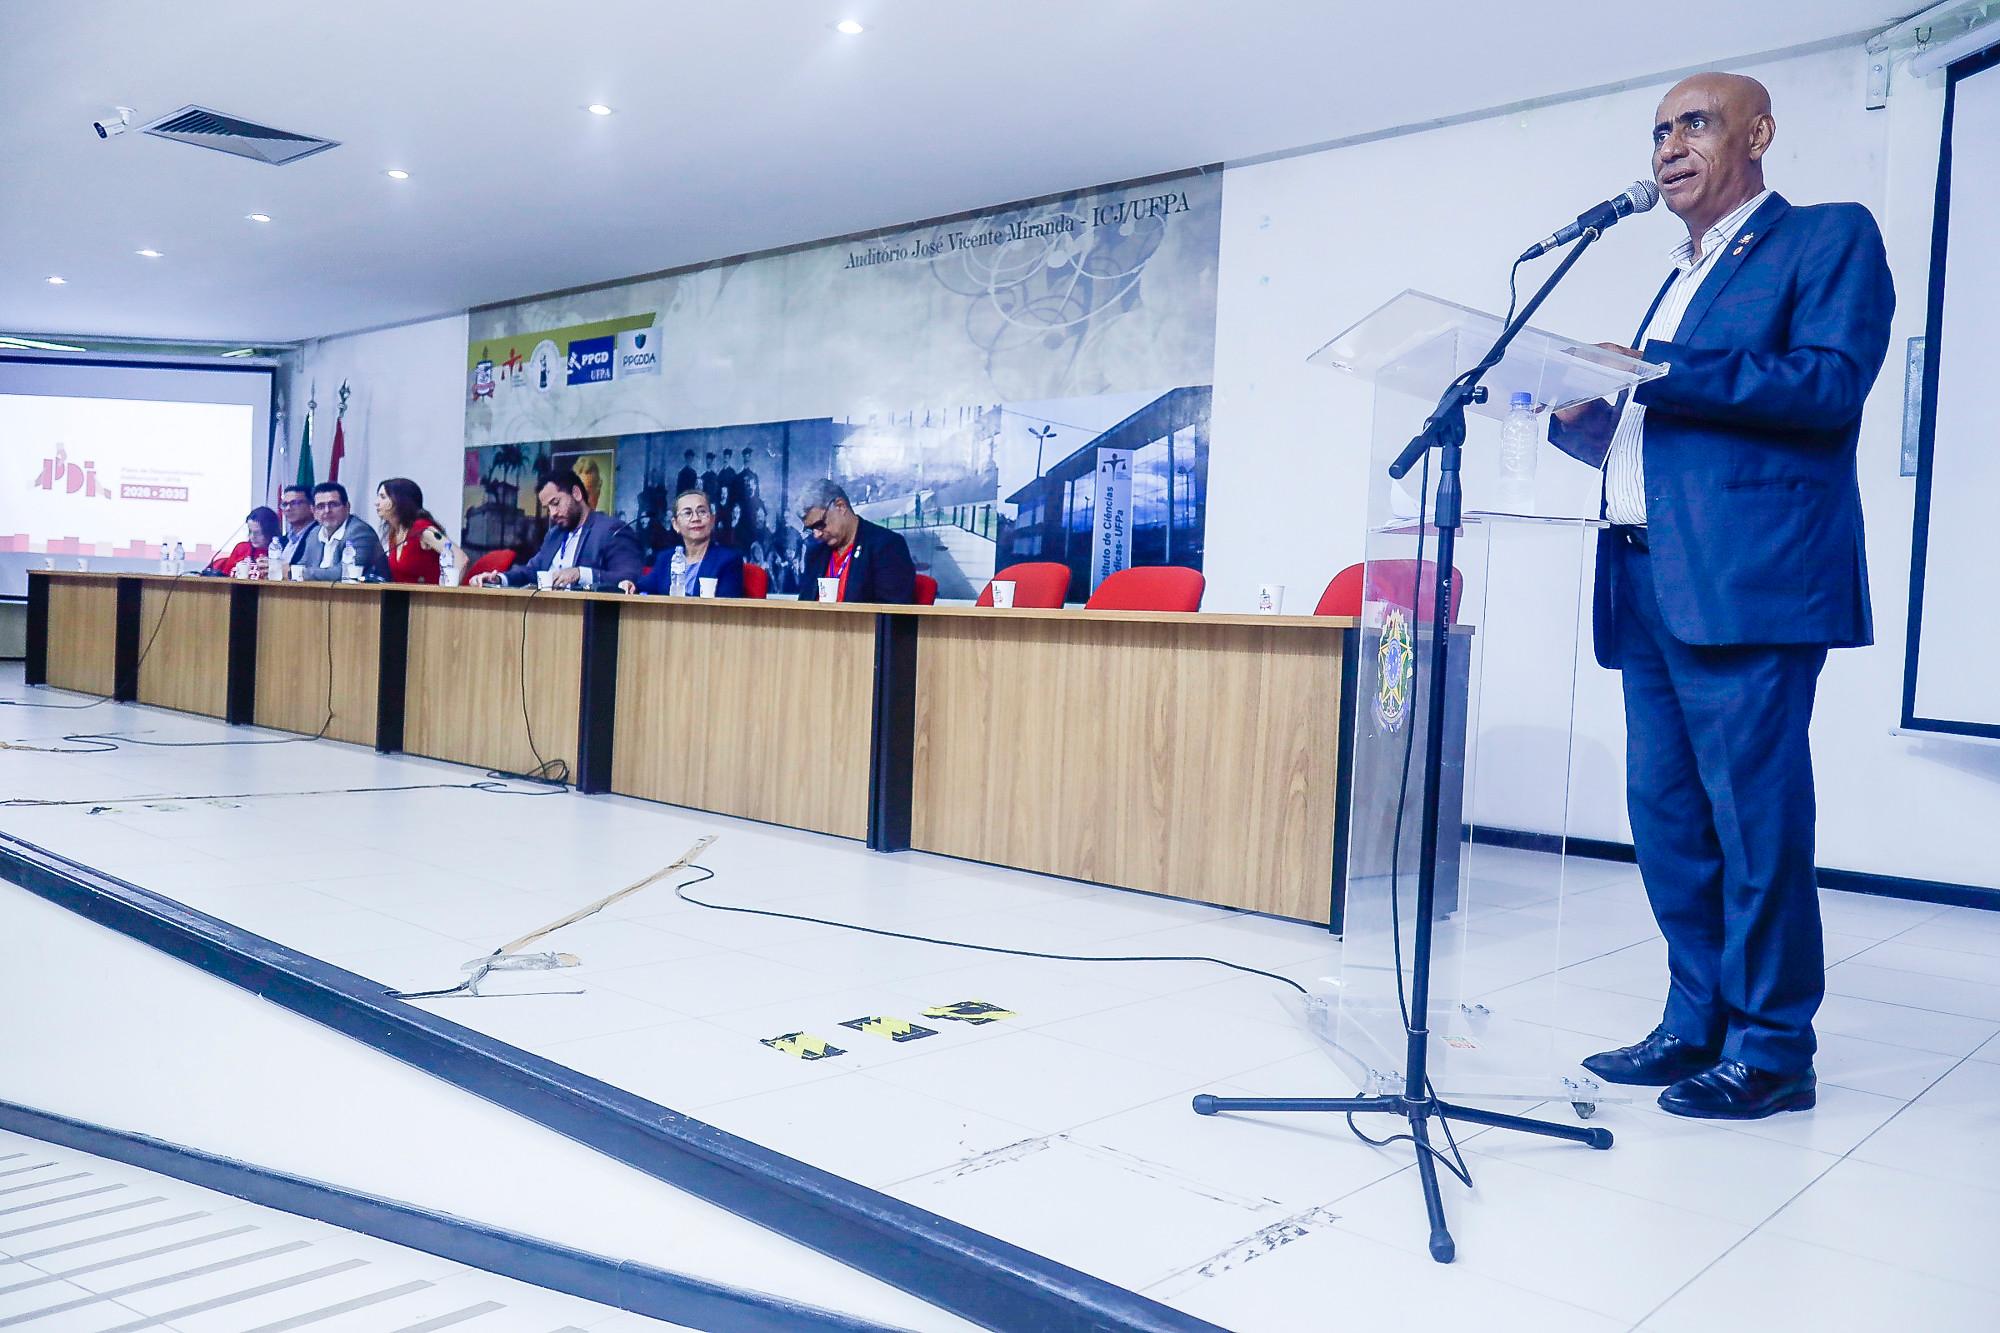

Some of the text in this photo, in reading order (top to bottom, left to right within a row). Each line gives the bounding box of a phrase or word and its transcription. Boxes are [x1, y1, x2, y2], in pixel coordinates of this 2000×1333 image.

[845, 243, 908, 269] Auditório
[911, 236, 944, 257] José
[947, 229, 1004, 251] Vicente
[1006, 213, 1075, 242] Miranda
[1092, 191, 1190, 227] ICJ/UFPA
[1103, 486, 1114, 530] Ciências
[1101, 548, 1111, 579] tituto
[1113, 540, 1123, 572] dicas-
